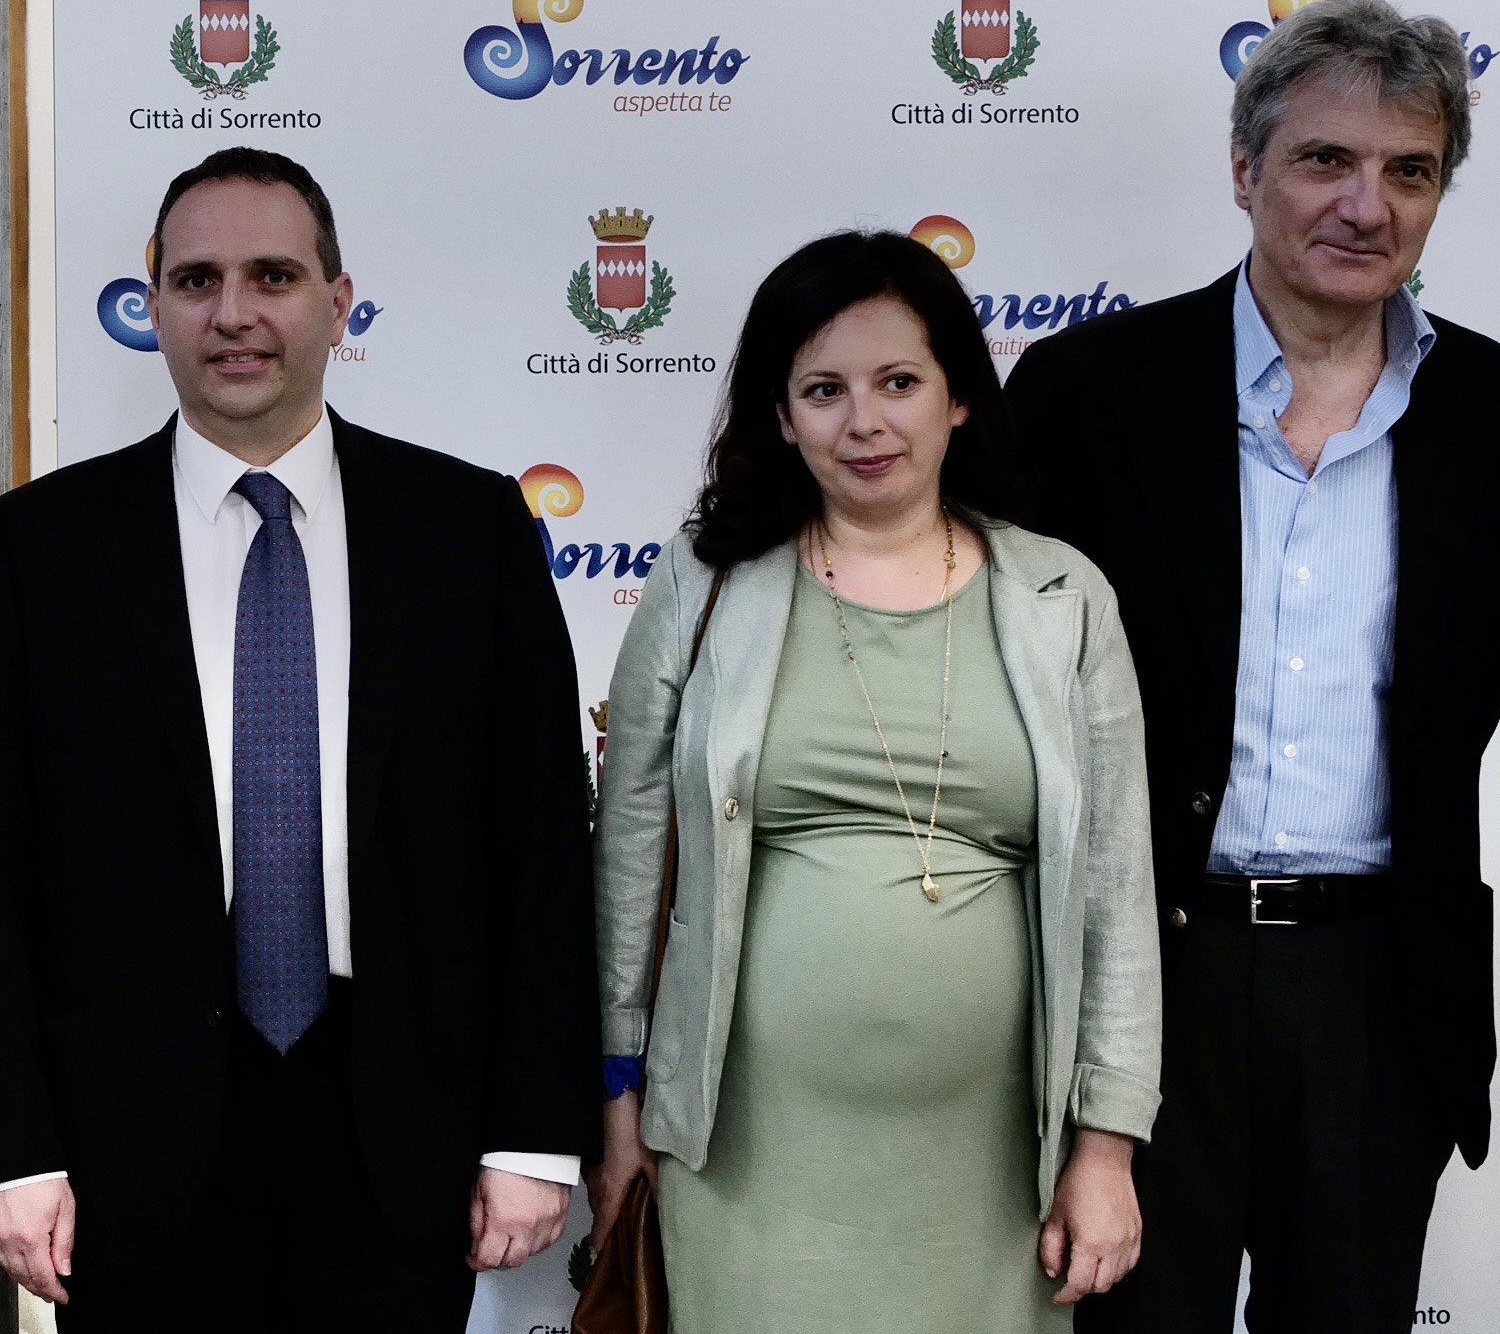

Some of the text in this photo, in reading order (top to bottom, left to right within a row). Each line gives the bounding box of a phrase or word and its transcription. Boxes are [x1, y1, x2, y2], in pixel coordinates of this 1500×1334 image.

[614, 92, 731, 117] aspetta te
[892, 103, 1079, 124] Città di Sorrento
[130, 108, 321, 129] Città di Sorrento
[972, 281, 1138, 330] rrento
[331, 345, 366, 362] You
[527, 353, 715, 374] Città di Sorrento
